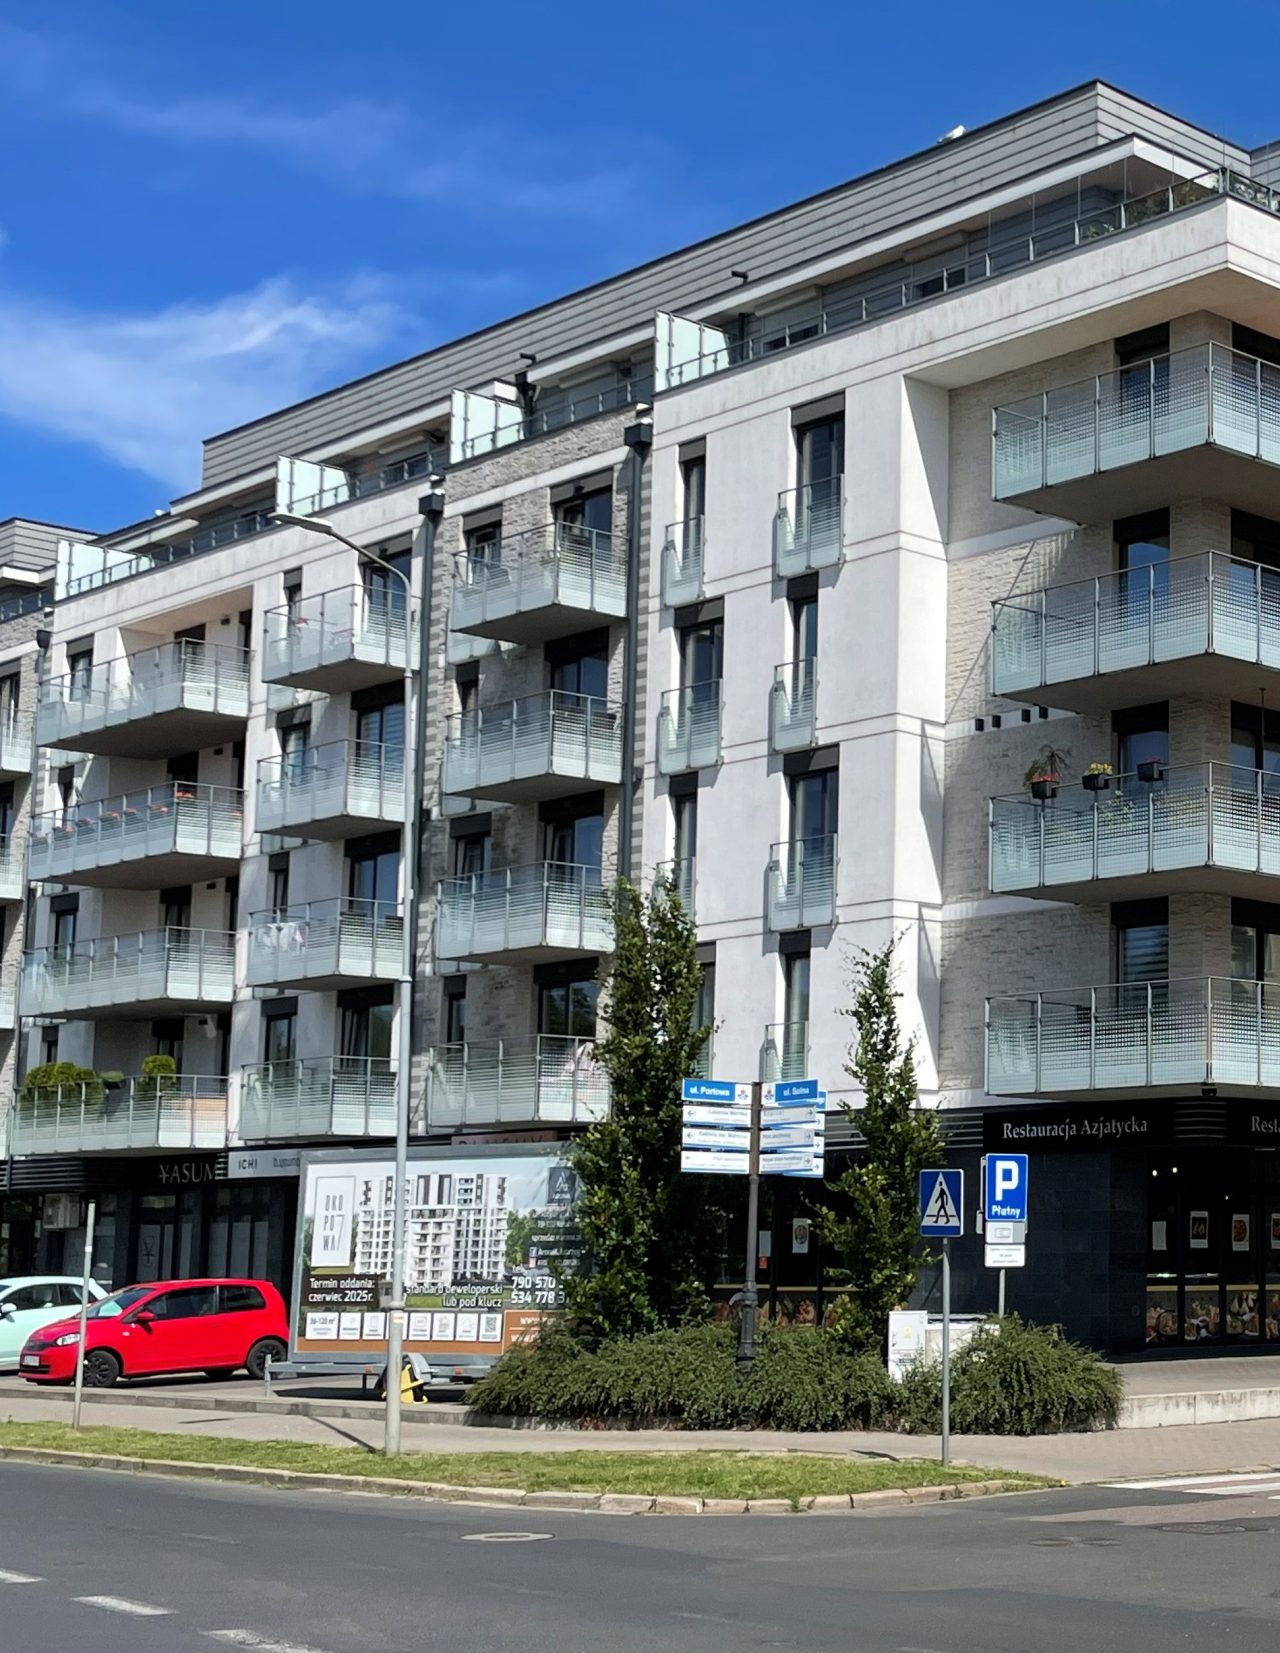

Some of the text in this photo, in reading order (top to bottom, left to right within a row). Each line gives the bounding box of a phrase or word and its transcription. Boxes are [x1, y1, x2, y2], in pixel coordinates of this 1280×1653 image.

[1002, 1116, 1148, 1141] Restauracja Azjatycka
[238, 1159, 258, 1170] ICHI
[995, 1161, 1019, 1201] P
[991, 1205, 1021, 1219] Płatny
[309, 1277, 376, 1289] Termin oddania:
[511, 1276, 532, 1288] 790
[535, 1276, 556, 1288] 570
[308, 1290, 374, 1302] czerwiec 2025r.
[406, 1284, 503, 1297] standard deweloperski
[442, 1295, 503, 1308] lub pod klucz
[511, 1291, 532, 1303] 534
[535, 1291, 556, 1303] 778
